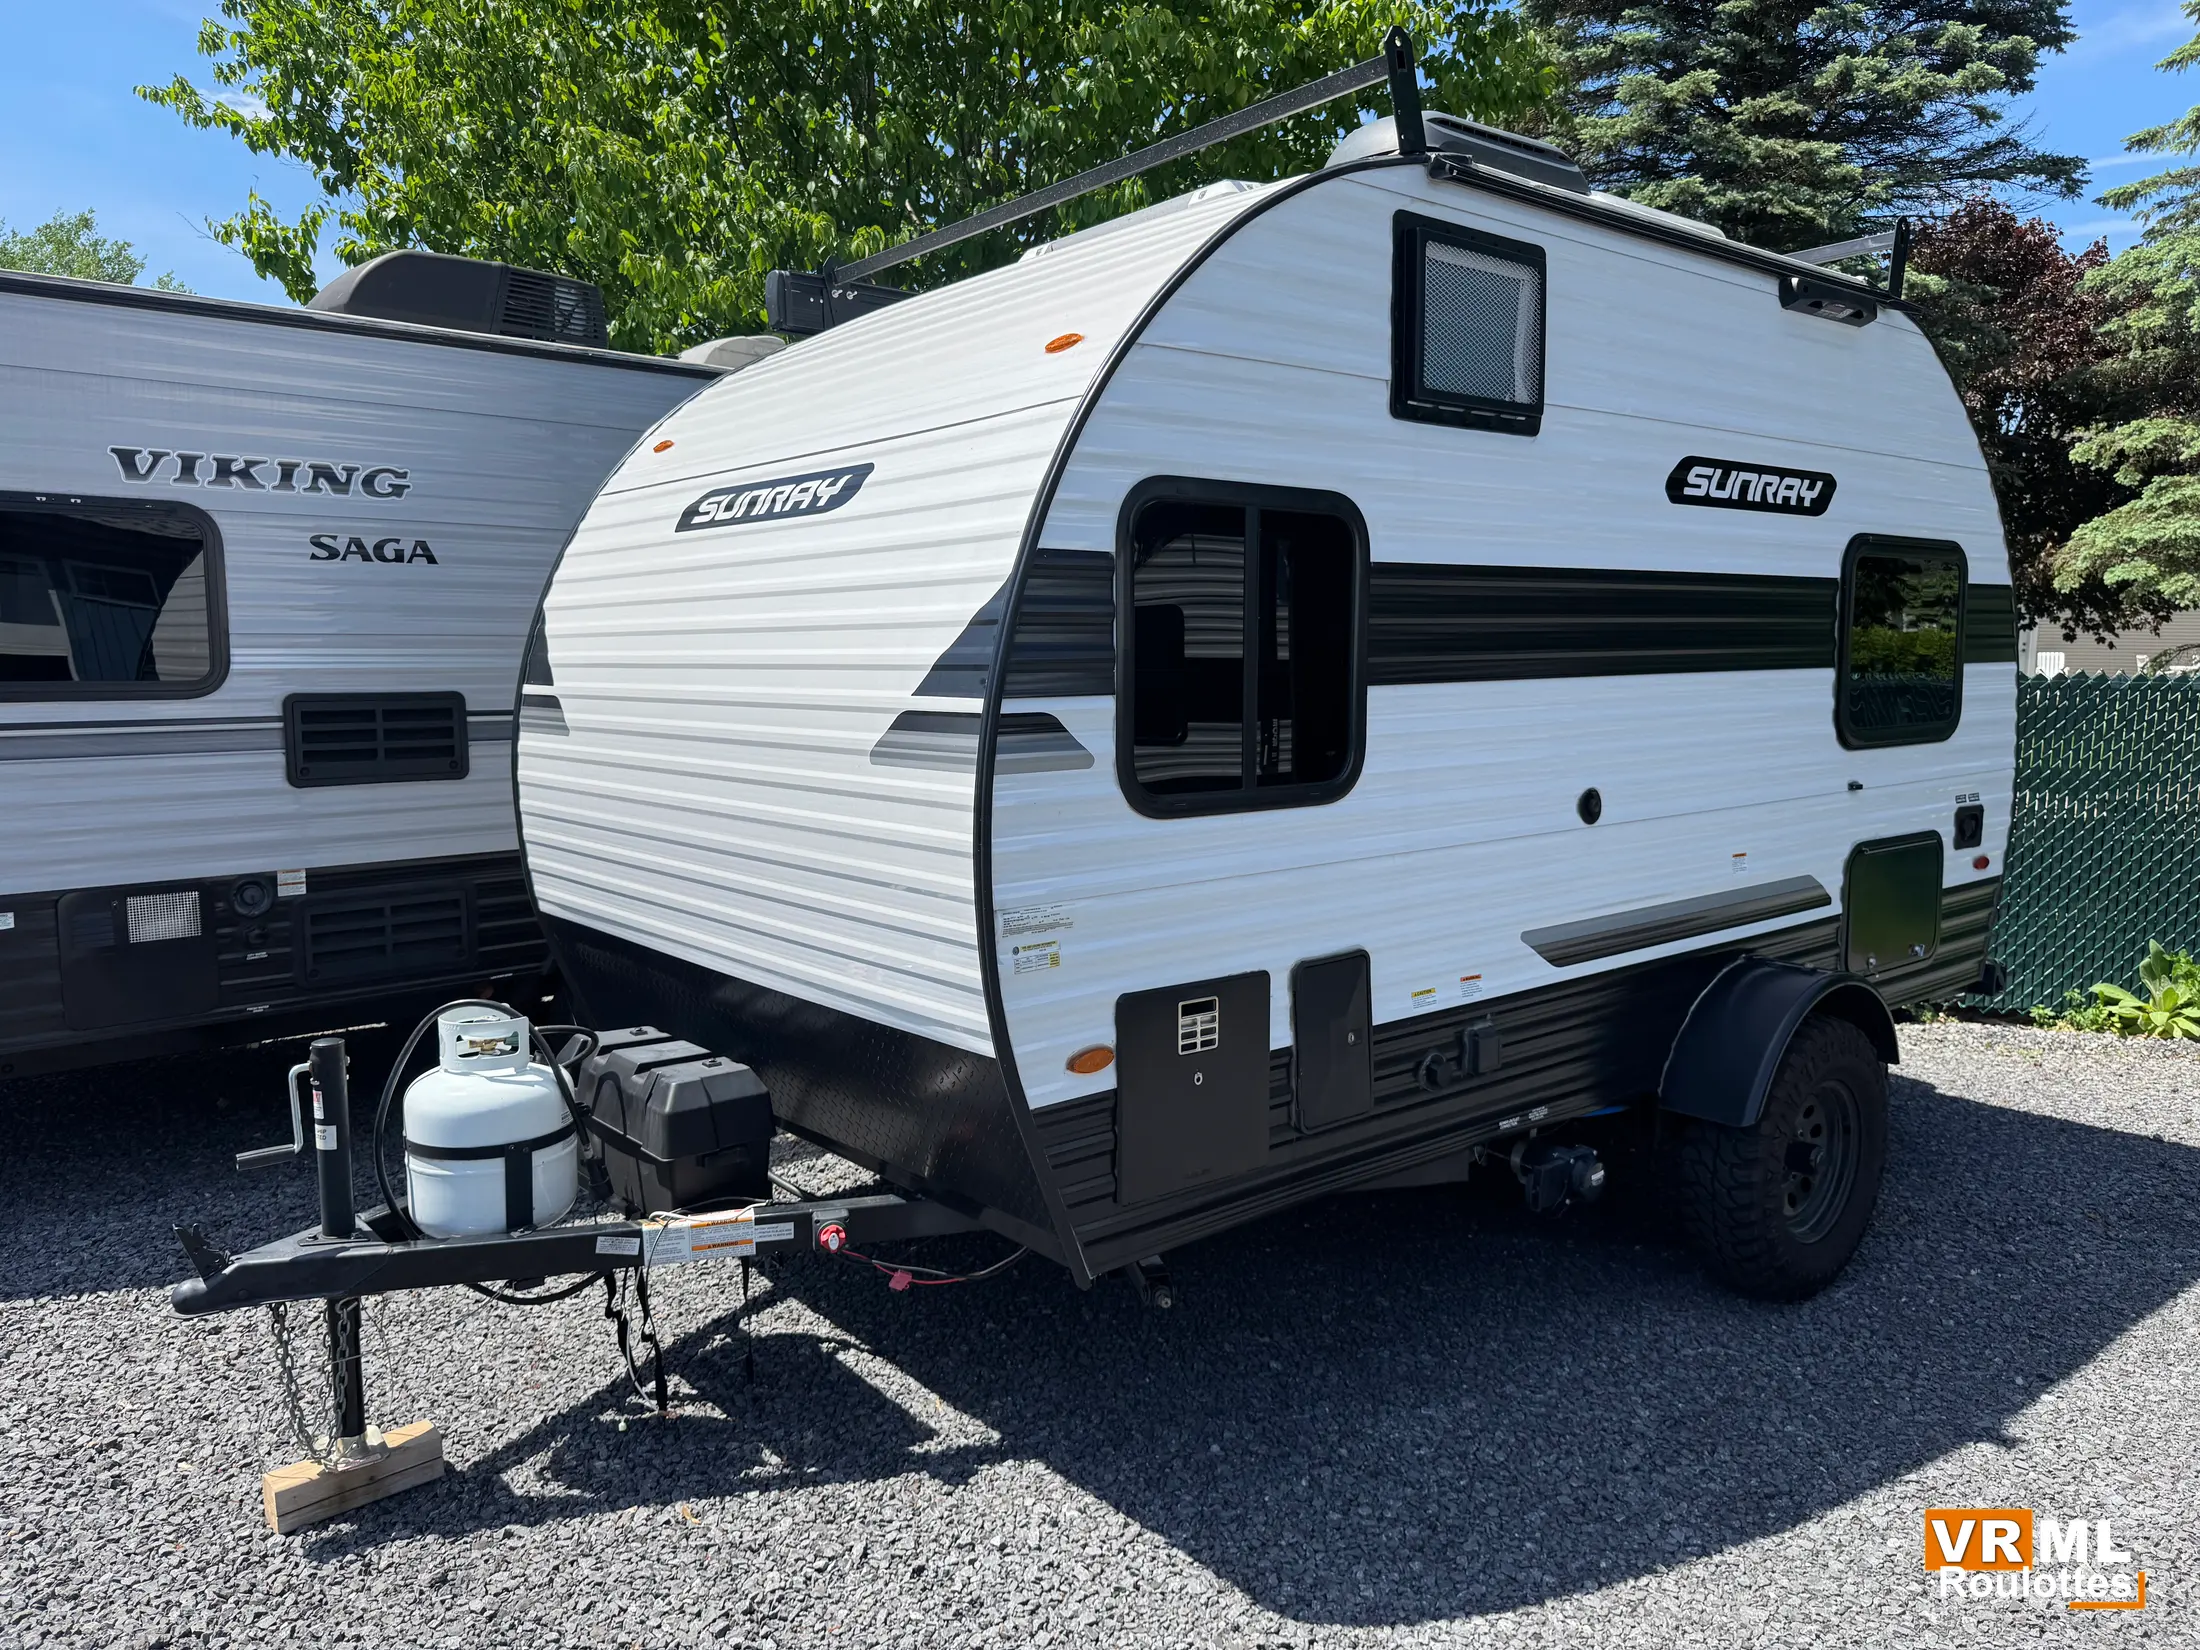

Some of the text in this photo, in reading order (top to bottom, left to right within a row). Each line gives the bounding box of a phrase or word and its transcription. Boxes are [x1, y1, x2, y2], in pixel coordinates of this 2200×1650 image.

[108, 446, 411, 499] VIKING
[1683, 466, 1823, 507] SUNRAY
[691, 475, 853, 524] SUNRAY
[309, 534, 439, 565] SAGA
